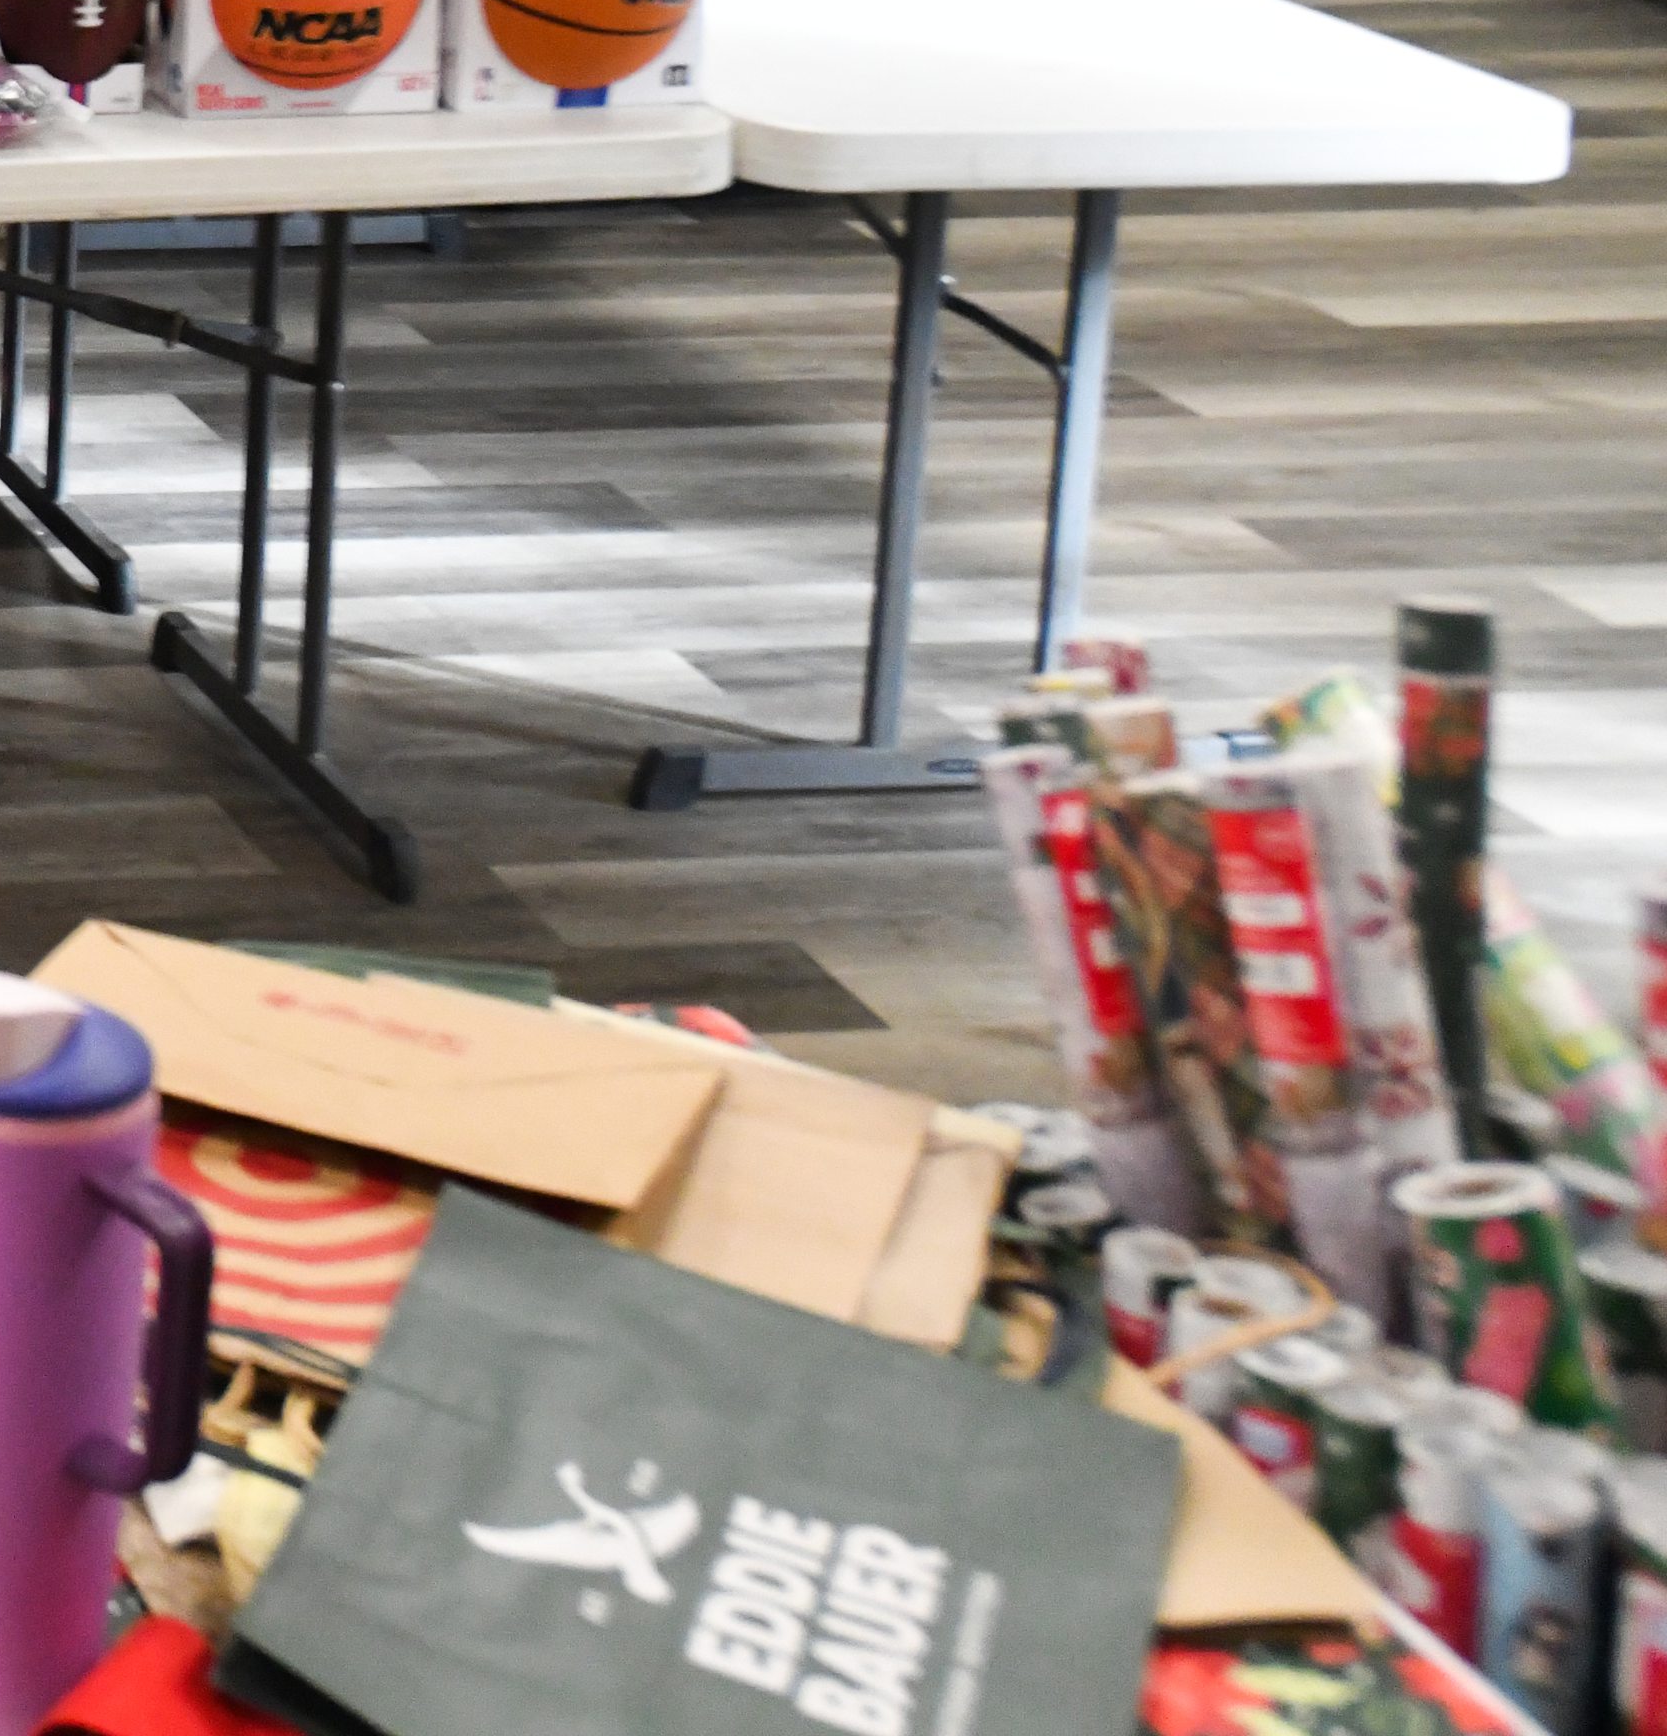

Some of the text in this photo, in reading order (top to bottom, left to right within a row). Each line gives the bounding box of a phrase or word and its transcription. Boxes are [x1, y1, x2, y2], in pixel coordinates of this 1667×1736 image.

[253, 6, 384, 44] NCAA
[684, 1493, 839, 1698] EDDIE
[793, 1521, 954, 1736] BAUER
